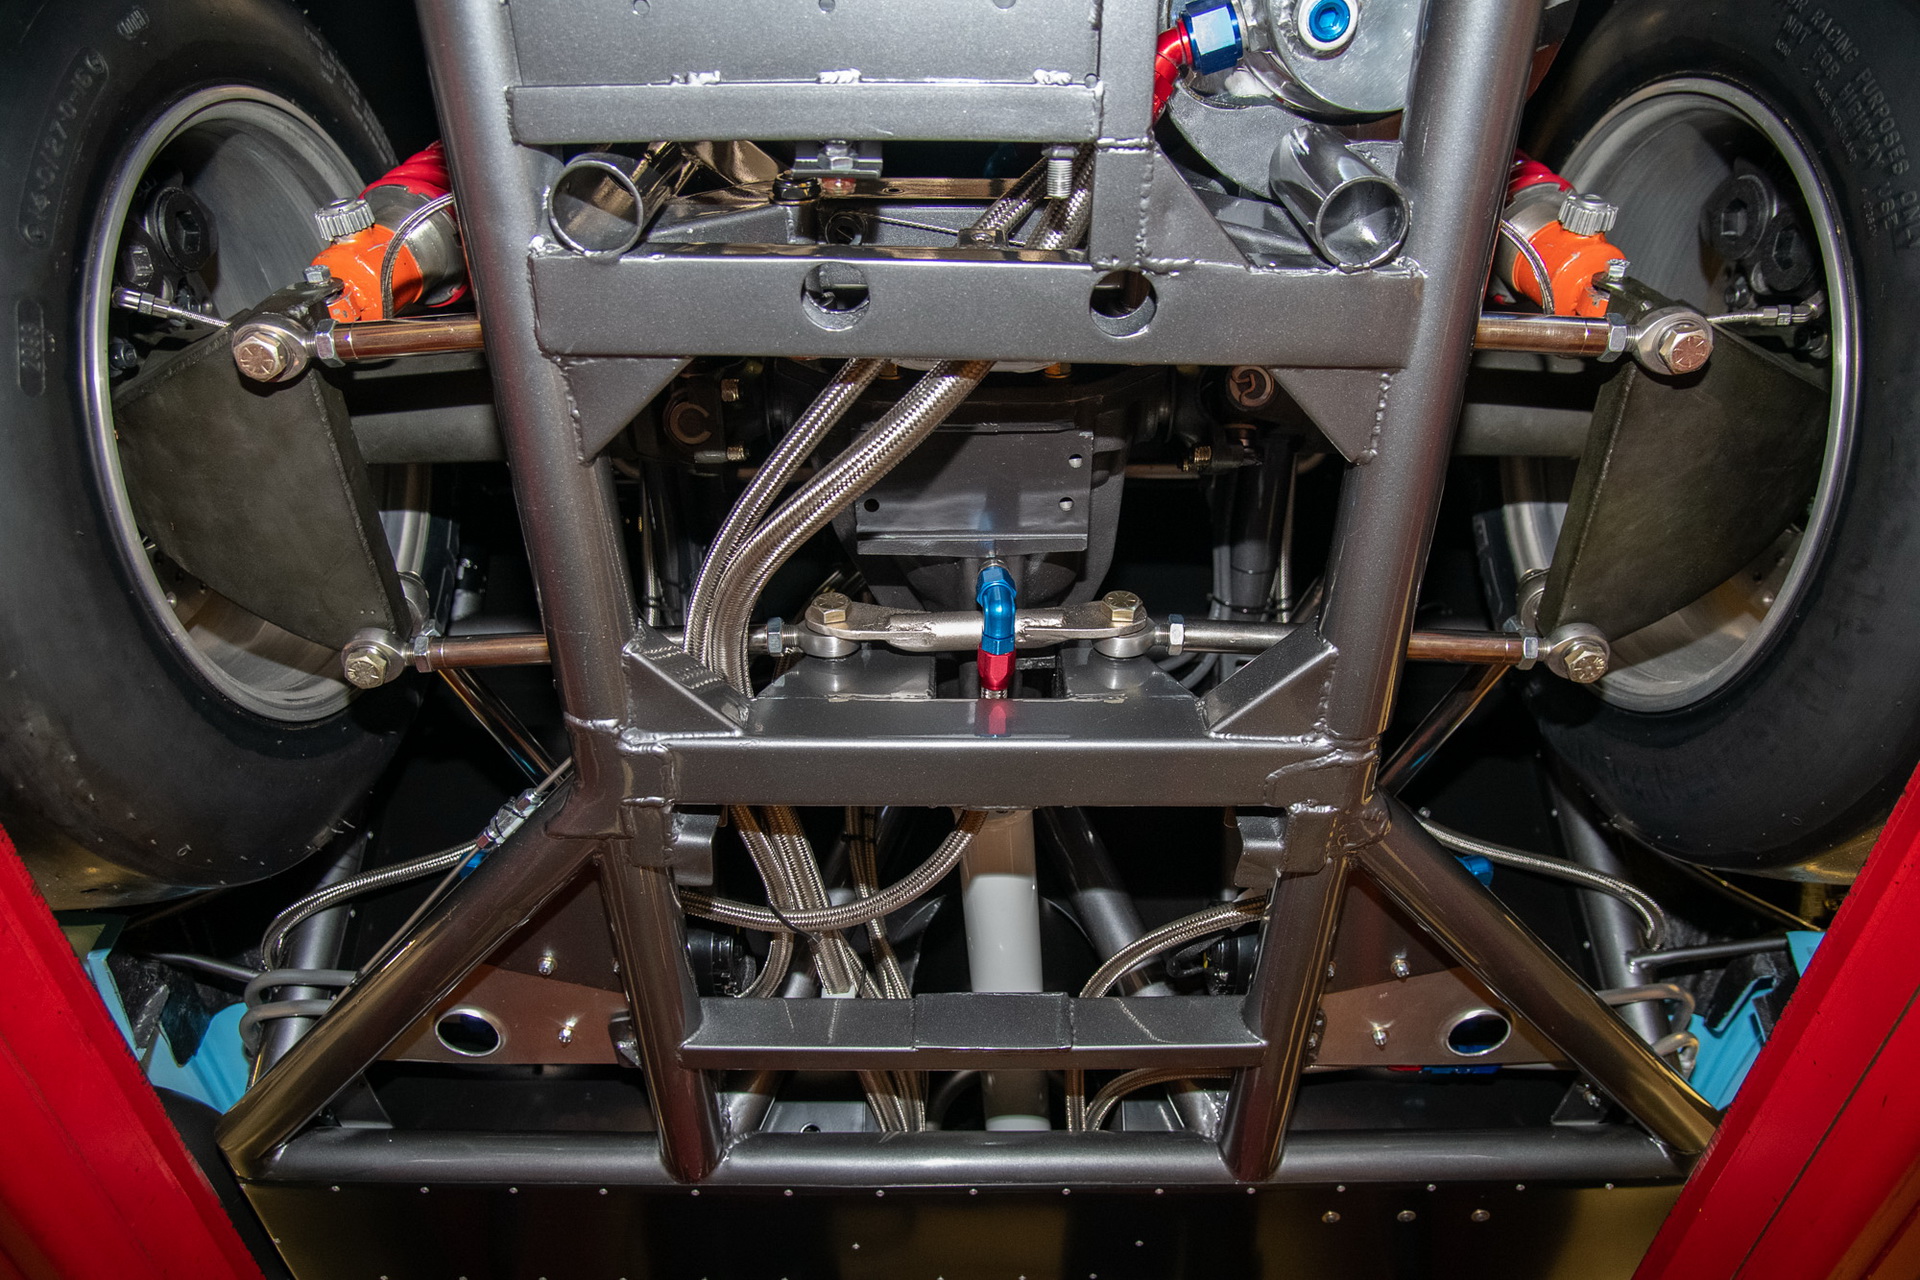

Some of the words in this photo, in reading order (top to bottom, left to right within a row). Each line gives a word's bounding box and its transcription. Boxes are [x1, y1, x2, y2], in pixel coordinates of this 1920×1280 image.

[1783, 14, 1812, 44] NOT
[1813, 44, 1840, 80] FOR
[1811, 8, 1859, 64] RACING
[1856, 67, 1910, 175] PURPOSES
